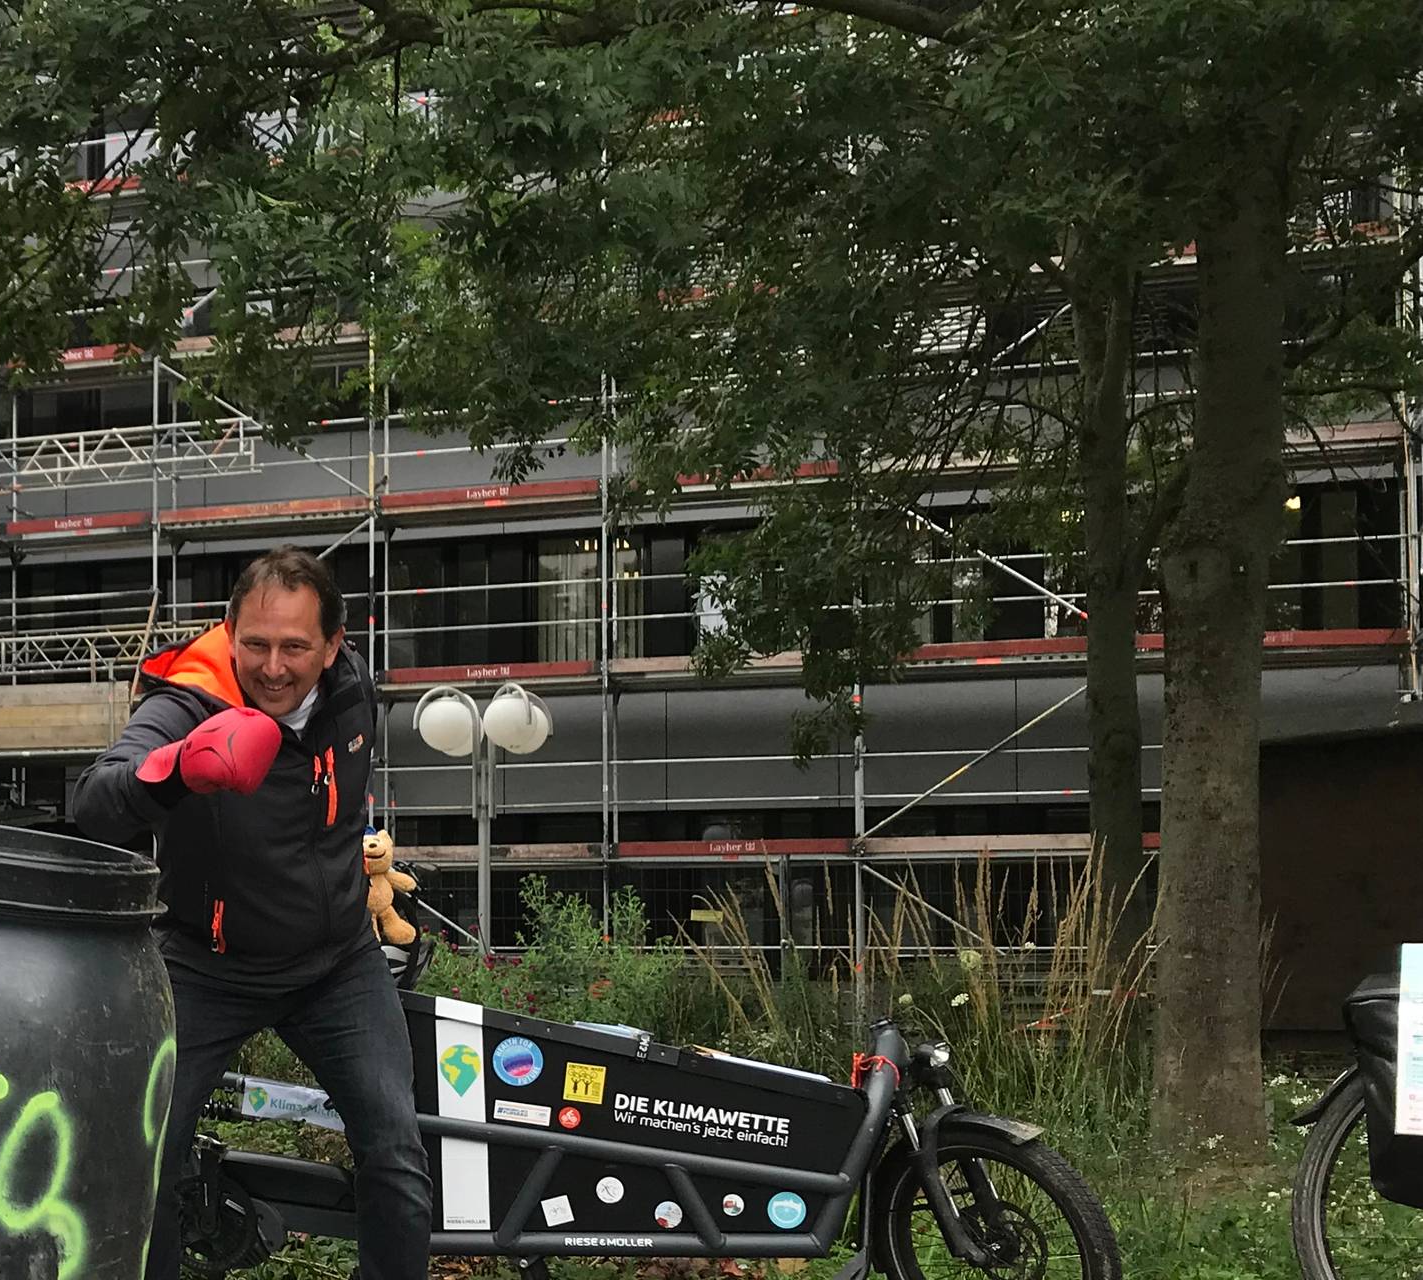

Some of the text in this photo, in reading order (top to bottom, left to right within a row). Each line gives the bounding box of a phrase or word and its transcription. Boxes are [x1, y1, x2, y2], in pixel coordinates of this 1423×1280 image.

[466, 488, 497, 499] Layher
[54, 519, 82, 530] Layher
[466, 667, 498, 679] Layher
[709, 842, 742, 854] Layher
[614, 1093, 790, 1135] DIE KLIMAWETTE
[613, 1110, 637, 1125] Wir
[702, 1123, 734, 1140] jetzt
[737, 1130, 789, 1148] einfach!
